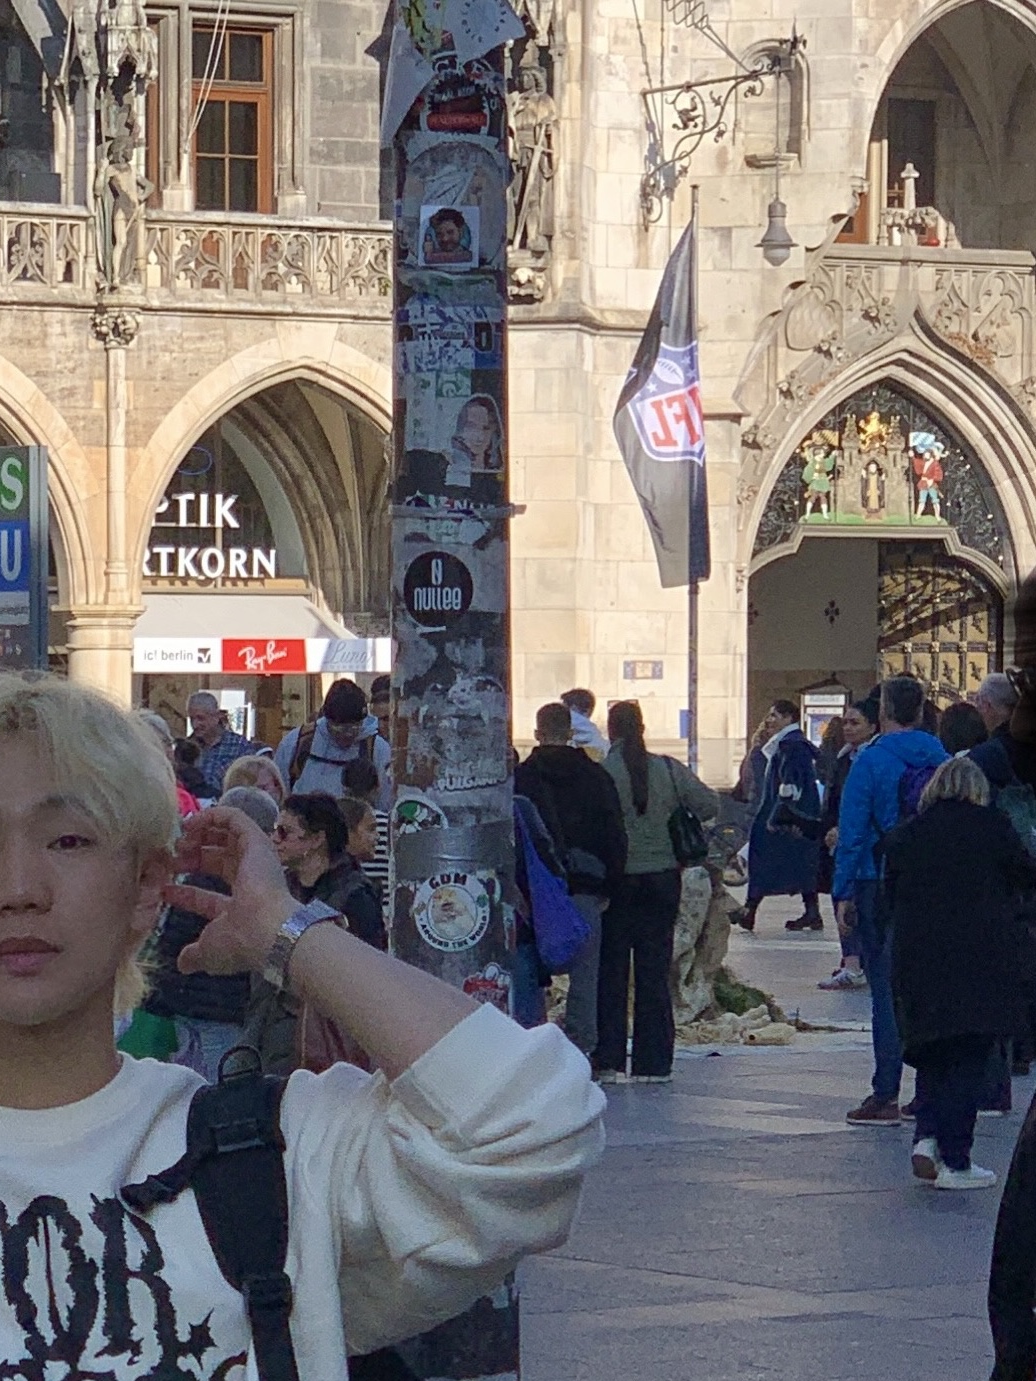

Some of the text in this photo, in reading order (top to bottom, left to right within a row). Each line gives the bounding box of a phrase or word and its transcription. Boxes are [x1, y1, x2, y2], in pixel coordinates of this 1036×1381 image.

[0, 456, 24, 511] S
[0, 529, 22, 582] U
[161, 649, 194, 662] berlin
